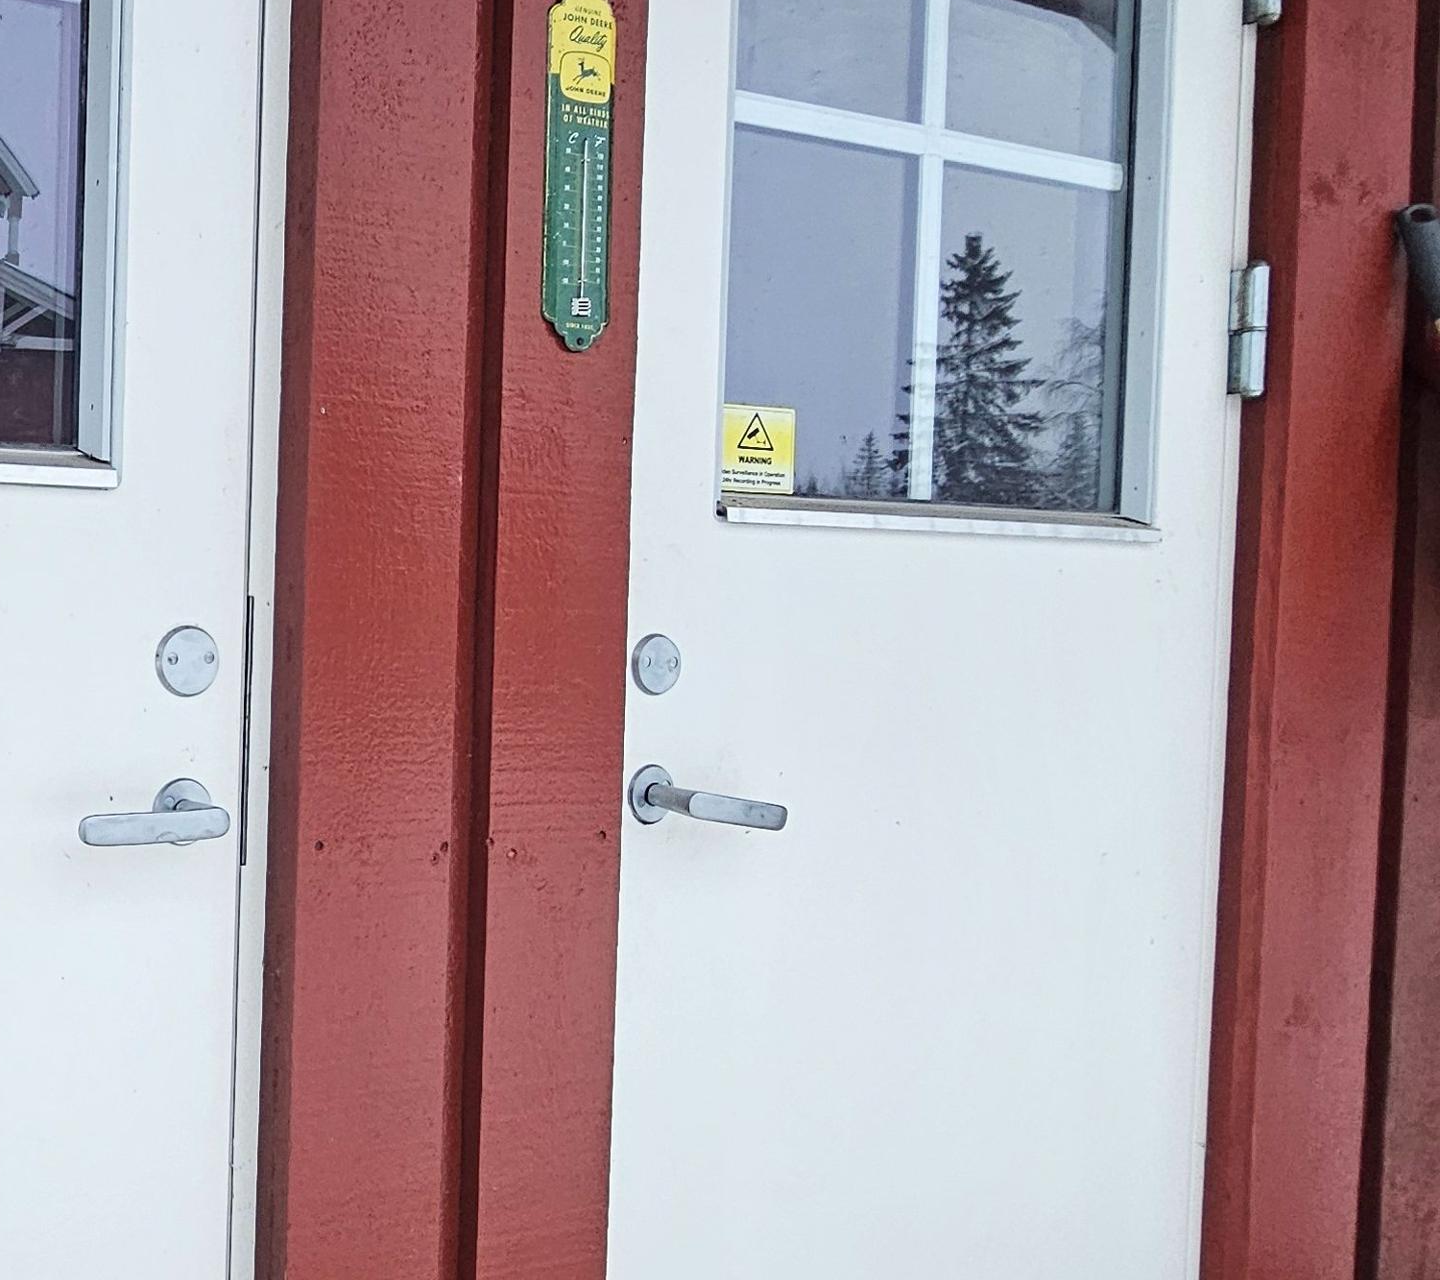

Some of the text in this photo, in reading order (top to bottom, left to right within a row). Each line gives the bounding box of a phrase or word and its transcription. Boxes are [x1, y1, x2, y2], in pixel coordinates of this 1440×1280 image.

[563, 12, 613, 30] JOHN DEERE
[569, 25, 608, 52] Quality
[565, 85, 584, 94] JOHN
[573, 105, 587, 115] ALL
[738, 456, 772, 465] WARNING
